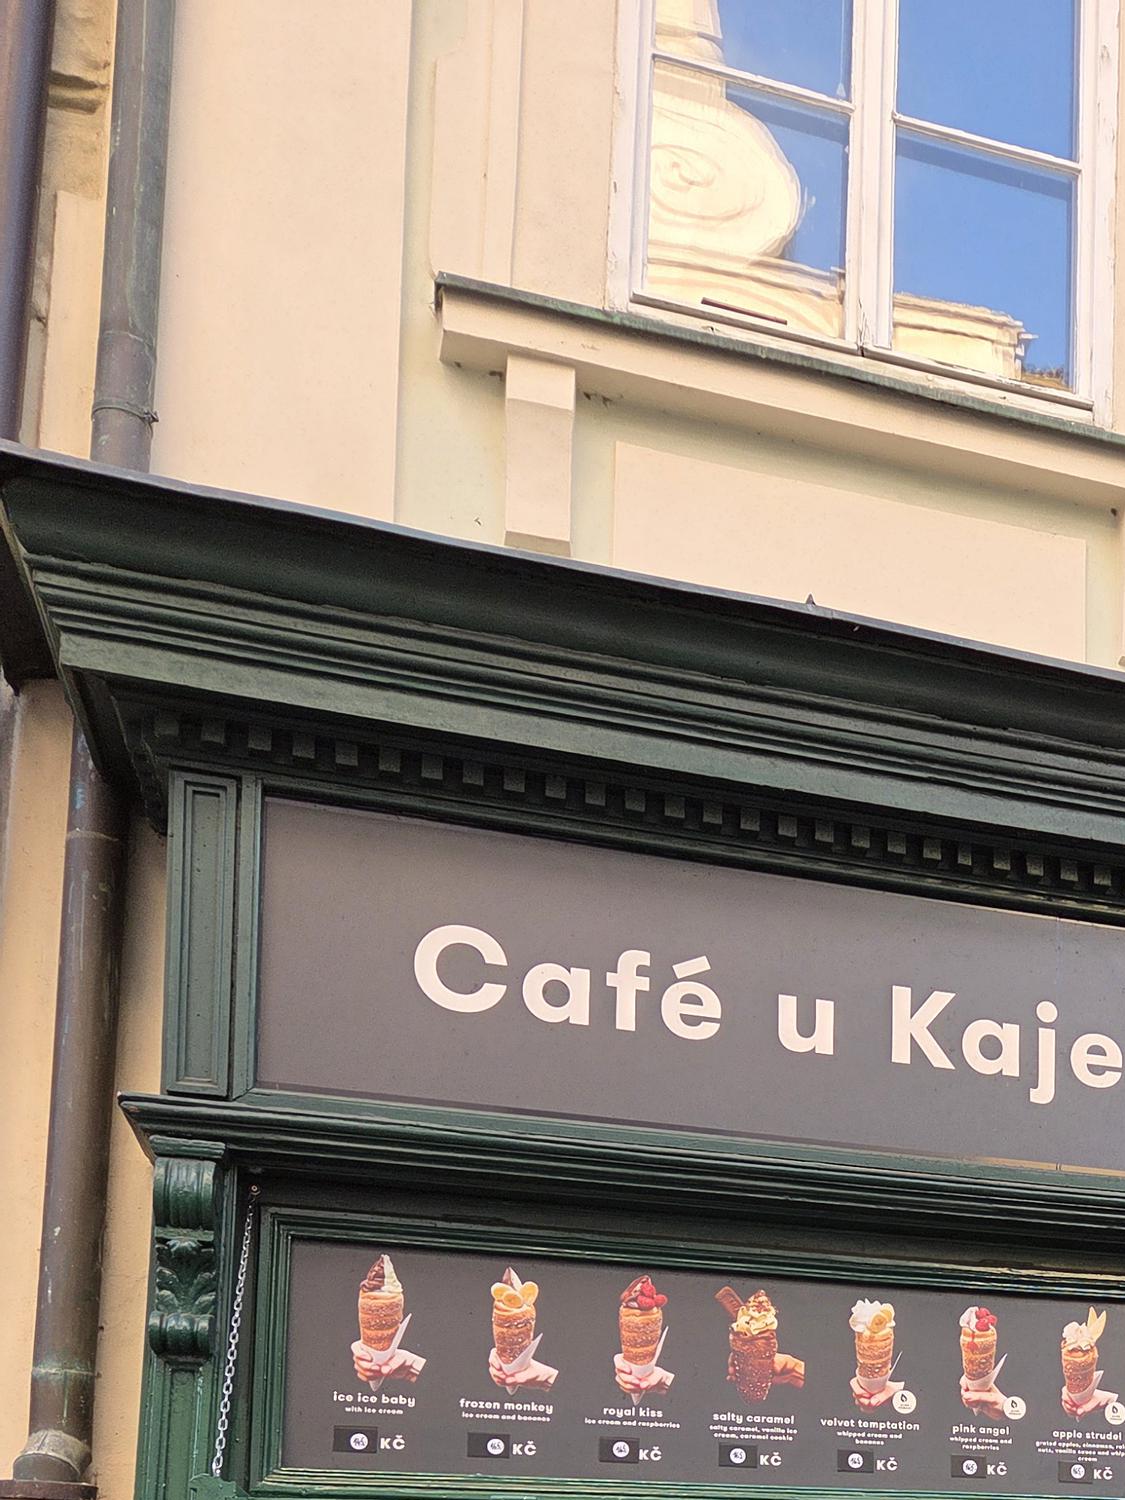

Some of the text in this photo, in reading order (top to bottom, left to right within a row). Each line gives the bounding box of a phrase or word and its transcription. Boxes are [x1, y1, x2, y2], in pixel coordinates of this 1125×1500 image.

[413, 923, 724, 1040] Café
[776, 993, 837, 1055] u
[333, 1391, 416, 1408] ice ice baby
[459, 1398, 553, 1415] frozen monkey
[603, 1406, 663, 1418] royal kiss
[713, 1411, 795, 1425] salty caramel
[820, 1417, 920, 1432] velvet temptation
[952, 1424, 1010, 1437] pink angel
[380, 1434, 406, 1450] KČ
[1052, 1429, 1122, 1441] apple strudel
[512, 1440, 537, 1456] KČ
[638, 1446, 662, 1461] KČ
[759, 1452, 782, 1467] KČ
[876, 1458, 898, 1471] KČ
[986, 1463, 1008, 1476] KČ
[1093, 1466, 1113, 1480] KČ
